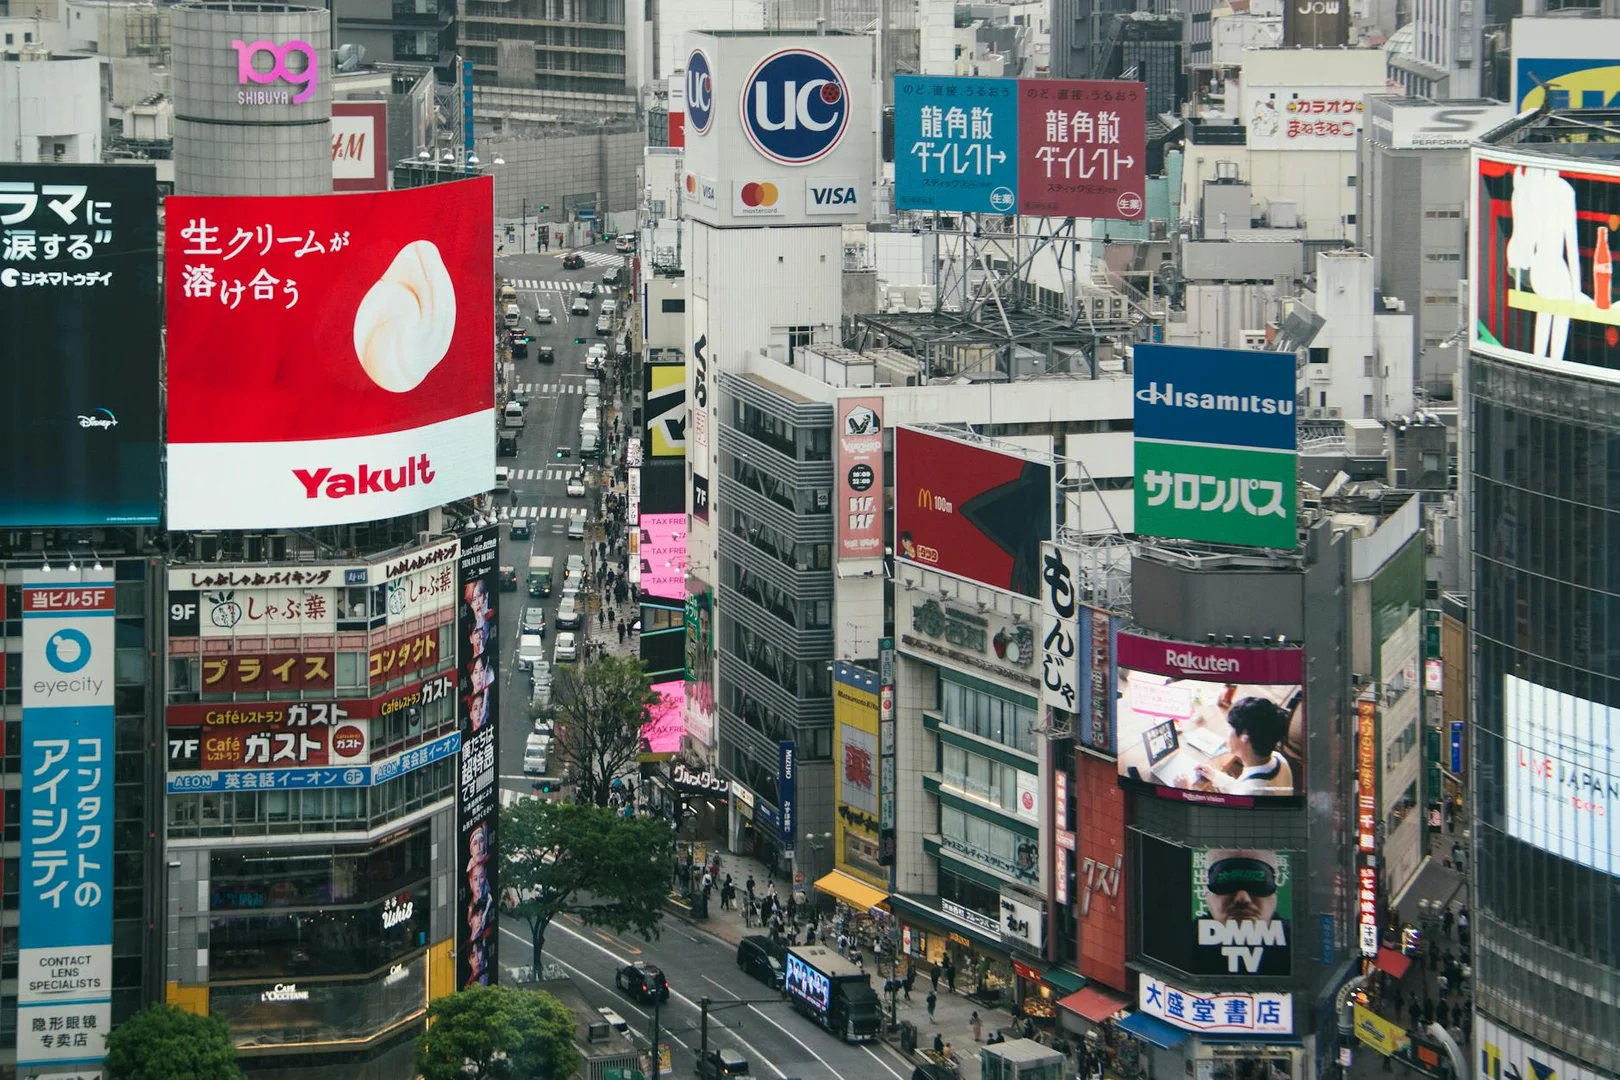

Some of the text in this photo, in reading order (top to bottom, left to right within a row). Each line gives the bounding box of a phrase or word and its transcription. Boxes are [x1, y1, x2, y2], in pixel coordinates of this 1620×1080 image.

[231, 39, 318, 105] 109
[237, 90, 289, 105] SHIBUYA
[688, 70, 711, 111] UC
[755, 78, 839, 132] UC
[1297, 101, 1355, 114] カラオケ
[921, 105, 993, 139] 龍角散
[1045, 110, 1120, 144] 龍角散
[1287, 120, 1356, 138] まねきねこ
[910, 142, 1006, 175] ダイレクト
[1035, 146, 1134, 180] ダイレクト
[702, 183, 715, 200] VISA
[810, 187, 857, 204] VISA
[180, 217, 350, 262] 生クリームが
[21, 270, 112, 287] シネマトゥデイ
[181, 263, 300, 310] 溶け合う
[1136, 382, 1293, 416] Hisamitsu
[77, 412, 118, 430] Disney+
[292, 453, 436, 499] Yakult
[695, 486, 706, 506] 7F
[1143, 469, 1286, 518] サロンパス
[386, 543, 458, 579] しゃぶしゃぶバイキング
[191, 570, 331, 588] しゃぶしゃぶバイキング
[409, 566, 452, 603] しゃぶ葉
[31, 591, 106, 609] 当ビル5F
[171, 603, 196, 621] 9F
[248, 595, 327, 621] しゃぶ葉
[1043, 547, 1075, 709] もんじゃ
[369, 634, 437, 678] コンタクト
[1166, 649, 1240, 673] Rakuten
[203, 657, 331, 685] プライス
[33, 677, 103, 698] eyecity
[421, 676, 453, 706] ガスト
[206, 703, 348, 727] Caféレストラン ガスト
[169, 738, 200, 759] 7F
[206, 738, 241, 752] Café
[207, 752, 240, 761] レストラン
[243, 732, 322, 764] ガスト
[336, 740, 362, 749] ガスト
[401, 738, 459, 772] 英会話イーオン
[376, 761, 398, 777] AEON
[462, 743, 494, 786] 超特急
[784, 749, 793, 780] MIZUHO
[1519, 747, 1553, 779] LIVE
[174, 776, 212, 789] AEON
[224, 771, 338, 788] 英会話イーオン
[346, 770, 362, 783] 6F
[674, 764, 730, 792] グルメタウン
[1559, 765, 1620, 799] JAPAN
[1182, 793, 1206, 802] Rakuten
[32, 739, 70, 909] アイシティ
[74, 738, 102, 907] コンタクトの
[382, 902, 413, 929] Ushi8
[1198, 919, 1286, 946] DMM
[39, 955, 92, 967] CONTACT
[1221, 946, 1263, 972] TV
[29, 978, 101, 991] SPECIALISTS
[51, 967, 79, 978] LENS
[1146, 982, 1280, 1025] 大盛堂書店
[32, 1015, 97, 1032] 隐形眼镜
[41, 1033, 88, 1048] 专卖店
